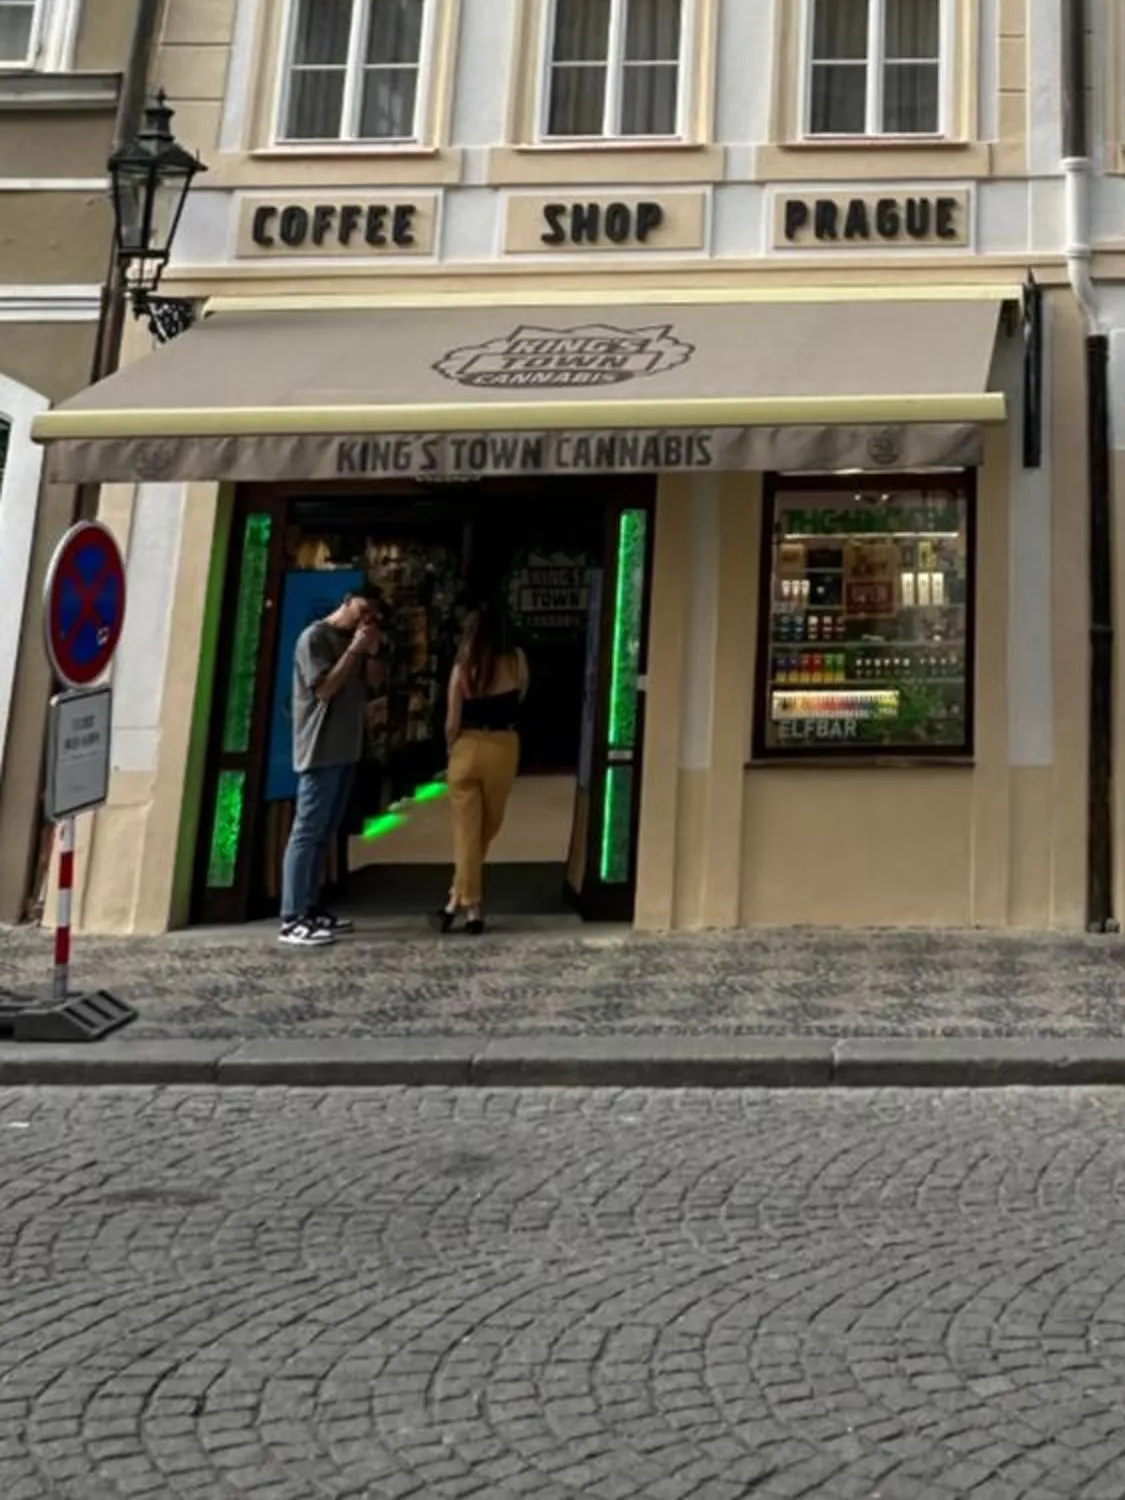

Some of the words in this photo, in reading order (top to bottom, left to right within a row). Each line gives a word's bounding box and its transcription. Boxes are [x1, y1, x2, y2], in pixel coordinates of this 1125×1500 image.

[251, 202, 417, 247] COFFEE
[540, 200, 664, 245] SHOP
[783, 195, 960, 241] PRAGUE
[503, 355, 629, 369] TOWN
[472, 371, 618, 386] CANNABIS
[449, 437, 542, 471] TOWN
[555, 434, 713, 469] CANNABIS
